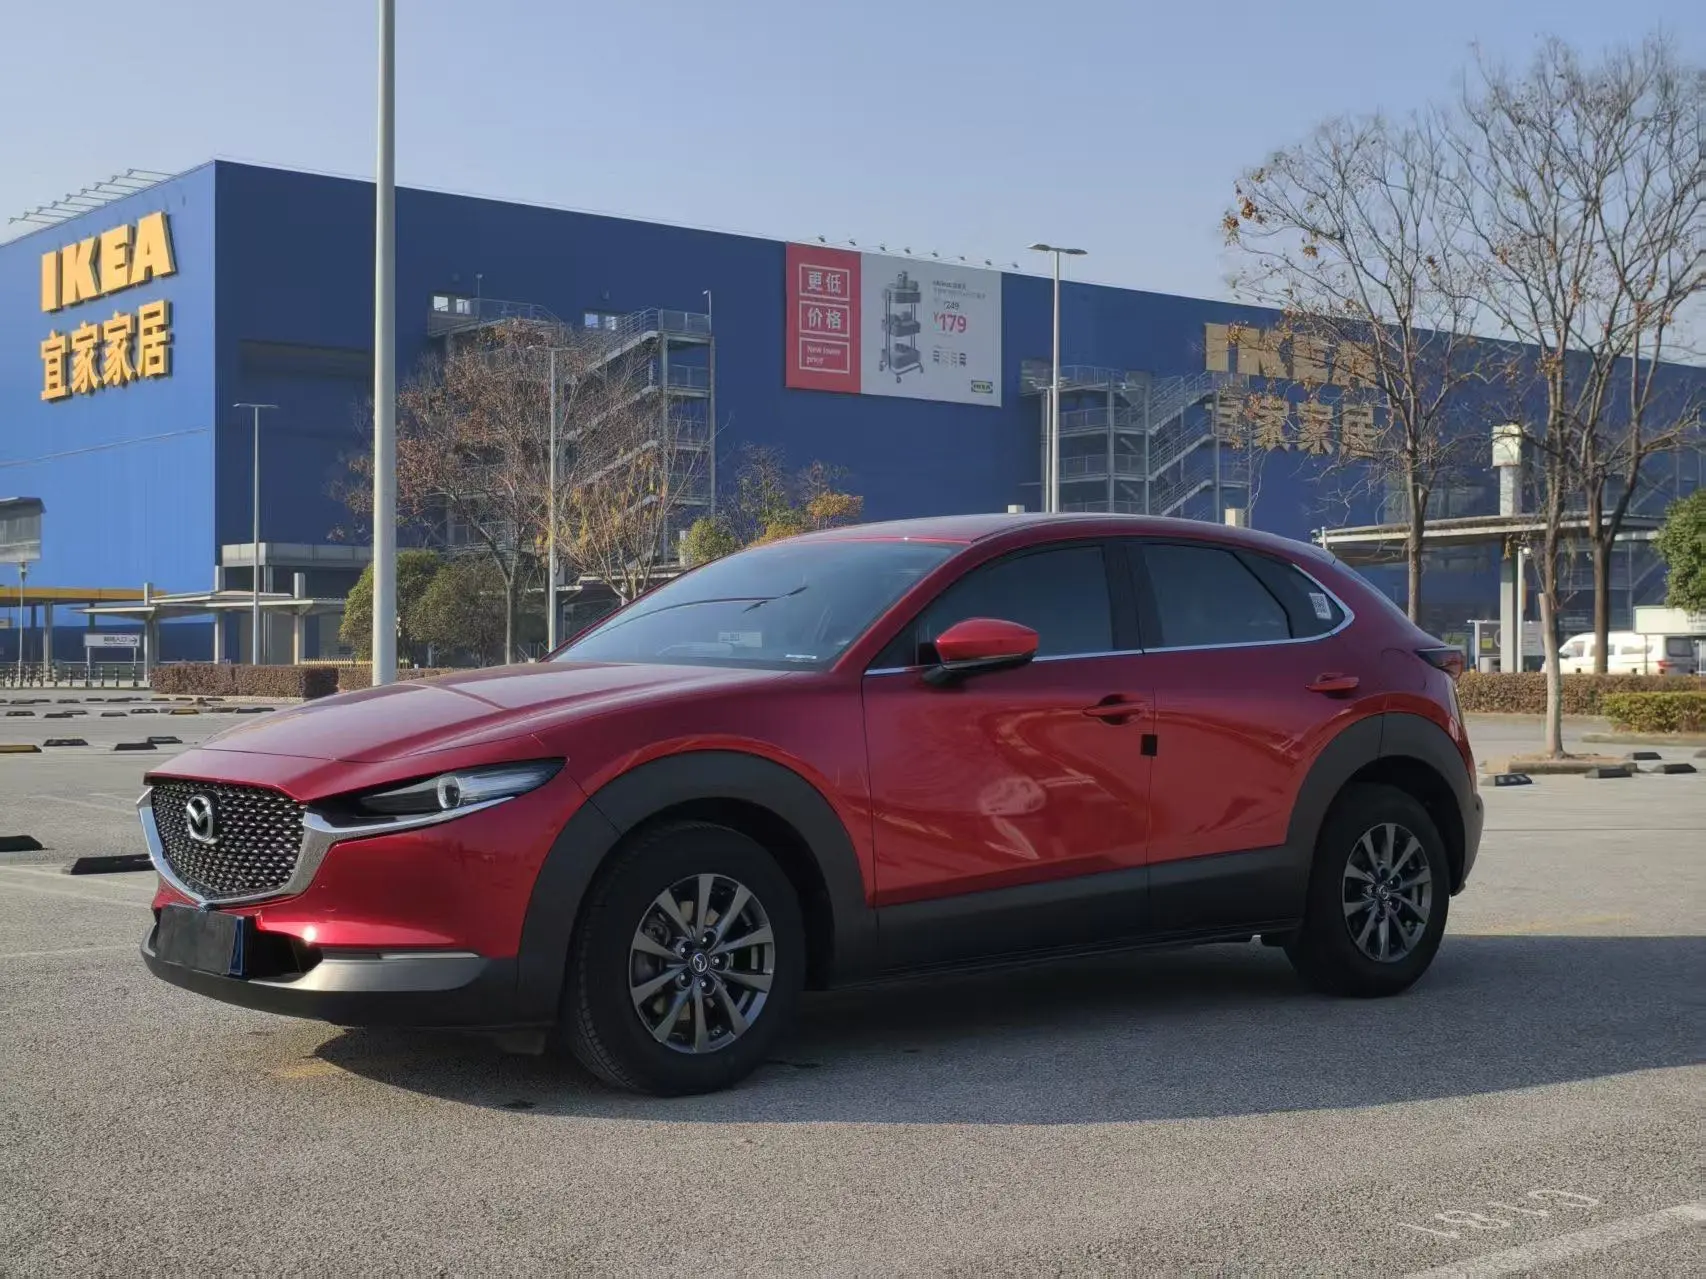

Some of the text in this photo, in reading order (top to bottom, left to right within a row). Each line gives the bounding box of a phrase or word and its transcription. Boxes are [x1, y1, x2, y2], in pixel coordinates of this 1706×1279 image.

[41, 211, 175, 313] IKEA
[808, 271, 841, 293] 更低
[41, 299, 173, 401] 宜家家居
[808, 307, 841, 329] 价格
[1205, 323, 1378, 388] IKEA
